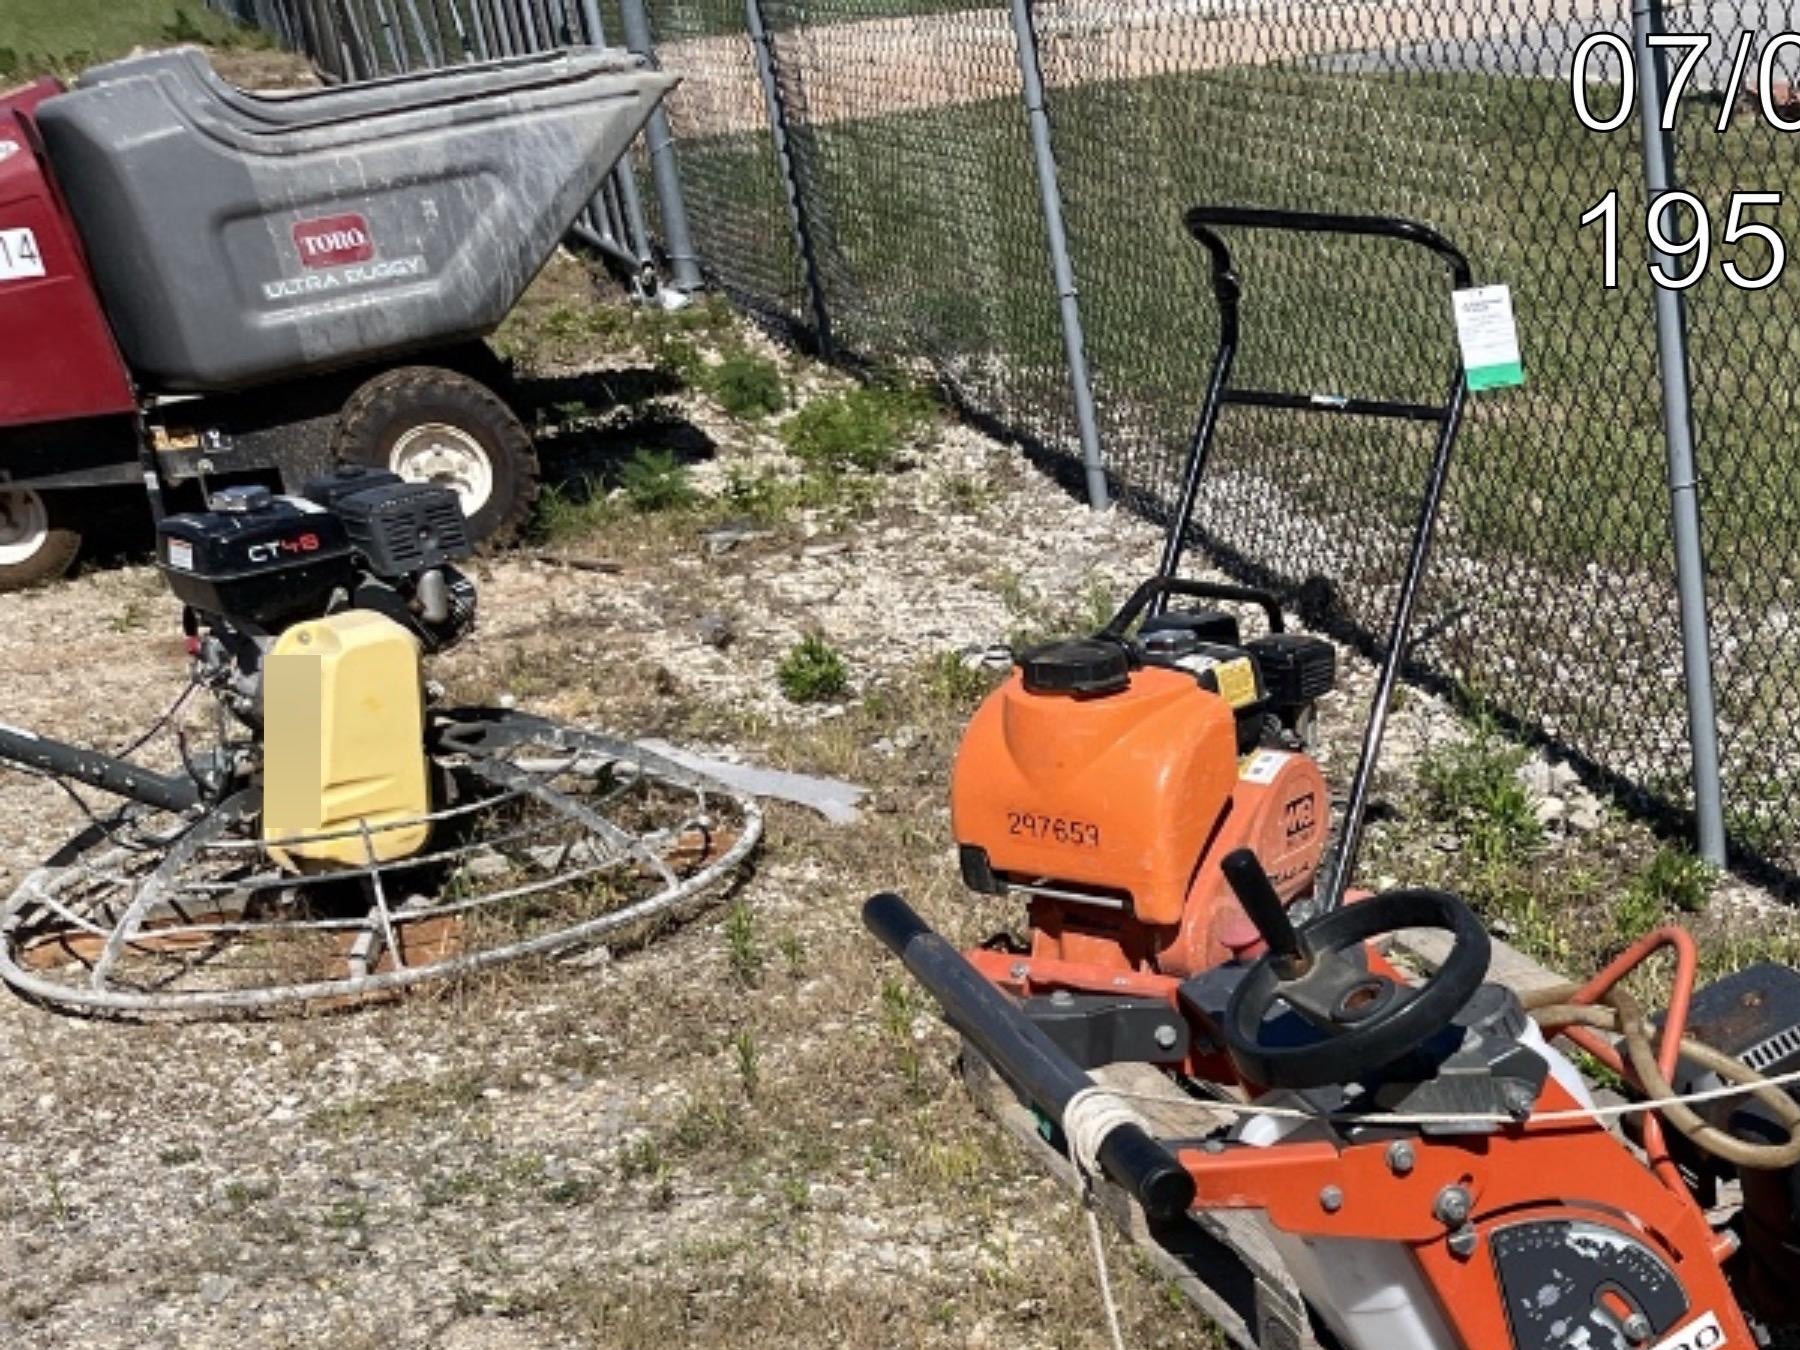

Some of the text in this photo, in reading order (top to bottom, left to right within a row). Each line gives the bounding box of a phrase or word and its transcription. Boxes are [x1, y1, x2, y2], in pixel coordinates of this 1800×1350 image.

[303, 227, 365, 256] TORO
[266, 255, 419, 300] ULTRA BUGGY
[248, 532, 321, 564] CT48
